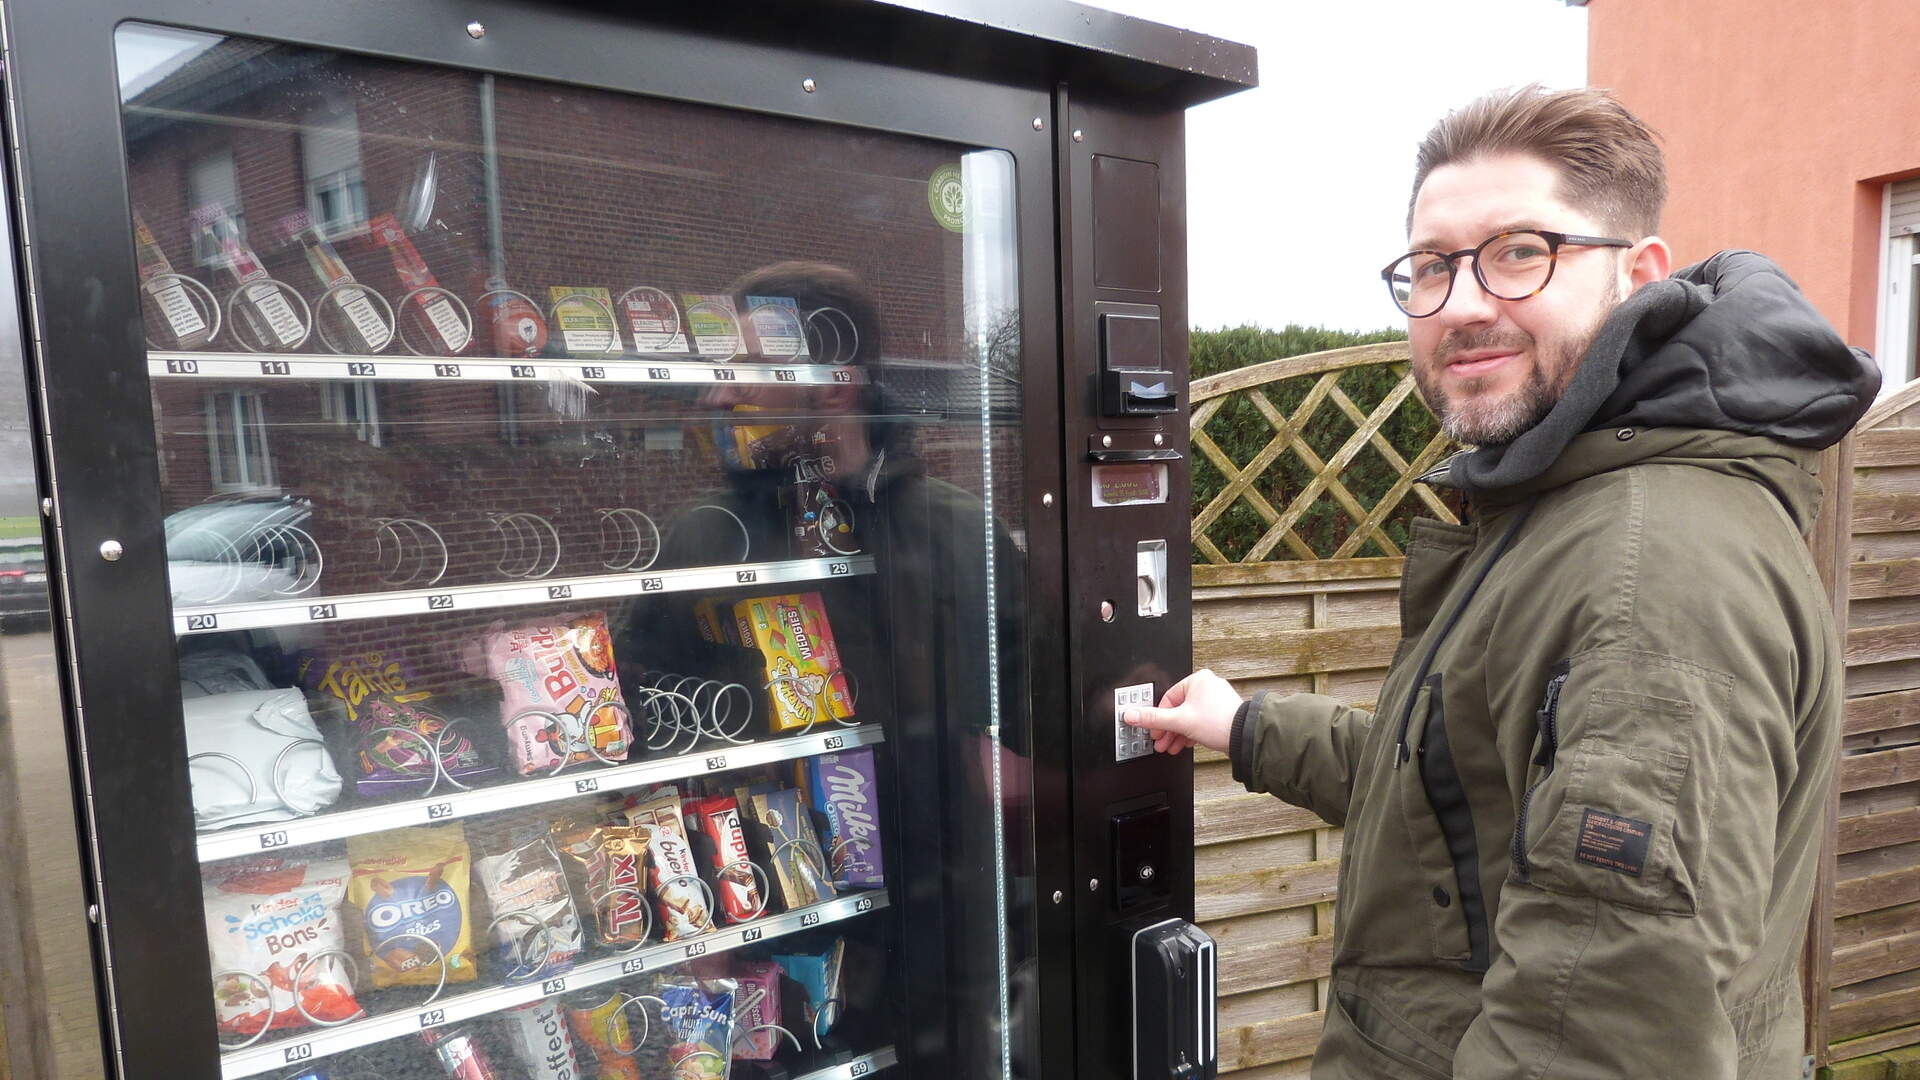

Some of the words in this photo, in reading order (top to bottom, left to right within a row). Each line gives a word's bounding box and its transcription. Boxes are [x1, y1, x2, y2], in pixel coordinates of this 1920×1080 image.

[171, 361, 196, 373] 10
[265, 362, 287, 374] 11
[352, 363, 374, 375] 12
[438, 364, 459, 376] 13
[515, 366, 534, 377] 14
[586, 367, 603, 378] 15
[652, 368, 668, 379] 16
[717, 370, 733, 380] 17
[778, 371, 794, 381] 18
[835, 372, 851, 382] 19
[833, 563, 847, 573] 29
[740, 571, 755, 581] 27
[645, 579, 661, 590] 25
[552, 586, 570, 598] 24
[431, 596, 452, 608] 22
[312, 605, 333, 617] 21
[190, 615, 215, 628] 20
[787, 610, 812, 660] WEDGIES
[776, 657, 812, 722] WARHEDS
[827, 737, 842, 748] 38
[709, 758, 725, 768] 36
[579, 779, 596, 791] 34
[431, 804, 451, 817] 32
[827, 765, 877, 855] Milka
[263, 832, 286, 846] 30
[610, 853, 642, 934] TWIX
[371, 891, 452, 928] OREO
[857, 900, 872, 911] 49
[804, 913, 818, 924] 48
[745, 928, 759, 940] 47
[265, 926, 318, 955] Bons
[690, 944, 705, 956] 46
[625, 960, 641, 971] 45
[546, 979, 563, 992] 43
[423, 1011, 443, 1024] 42
[660, 1002, 727, 1025] Capri-Sun
[536, 1009, 571, 1080] effect
[288, 1044, 310, 1059] 40
[853, 1063, 868, 1075] 59
